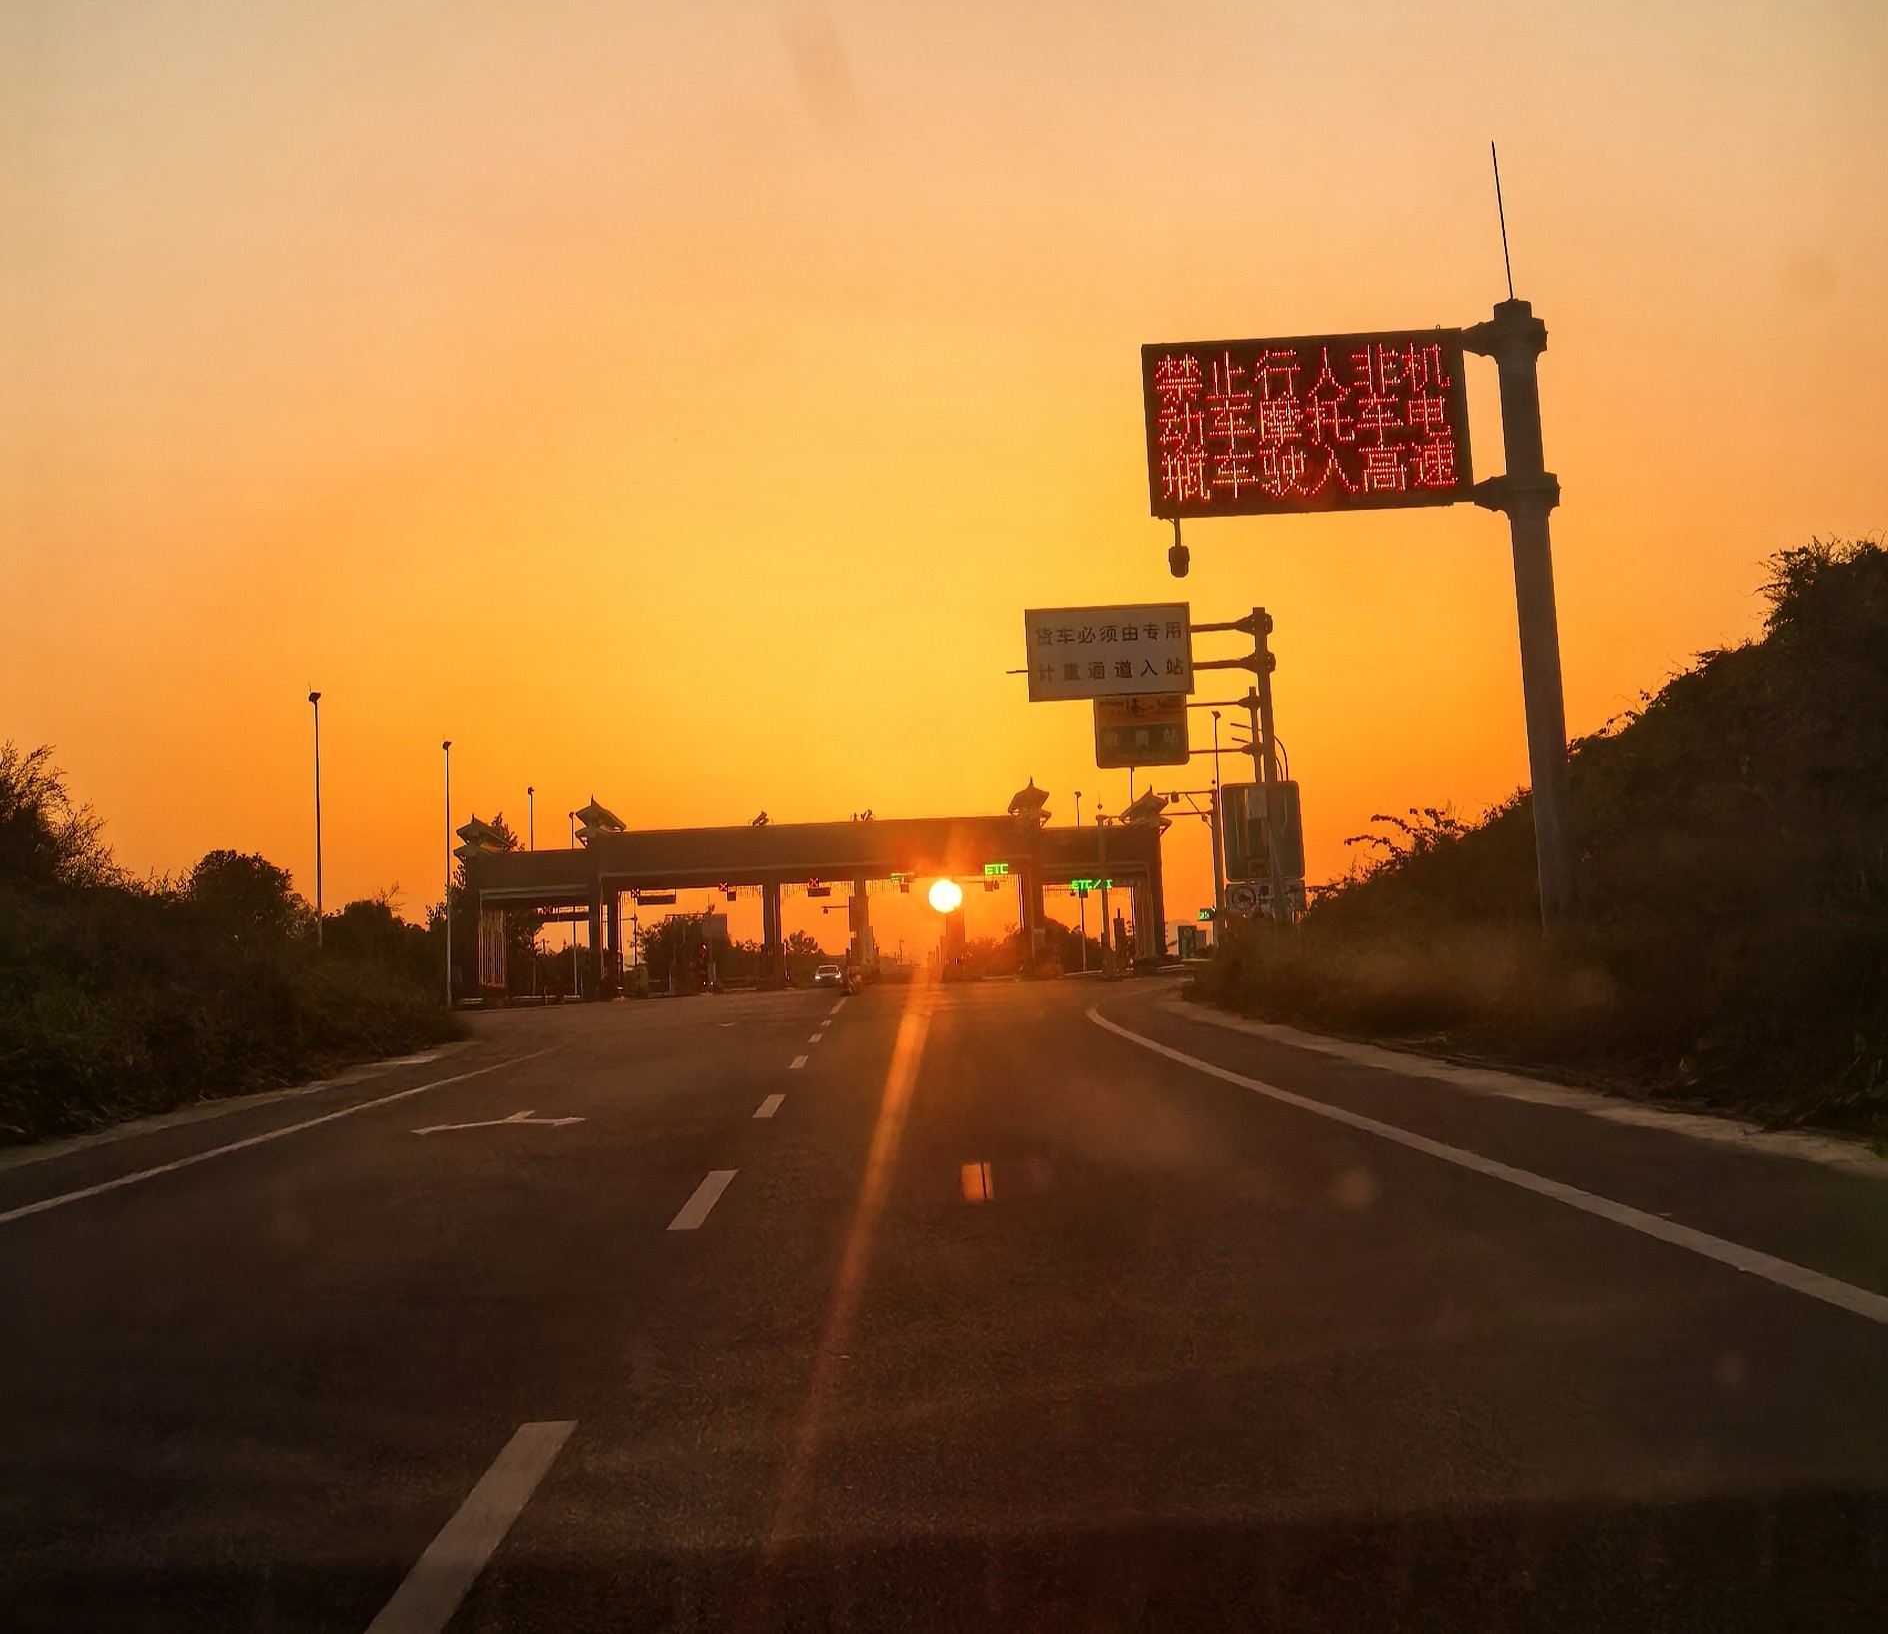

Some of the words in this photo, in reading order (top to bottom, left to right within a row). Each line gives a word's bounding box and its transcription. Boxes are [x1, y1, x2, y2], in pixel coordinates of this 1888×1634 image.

[1154, 340, 1453, 403] 禁止行人非机
[1157, 390, 1453, 454] 动车摩托车电
[1160, 437, 1459, 502] 瓶车驶入高速
[1035, 621, 1183, 646] 货车必须由专用
[1037, 658, 1184, 682] 计重通道入站
[984, 863, 1008, 875] ETC
